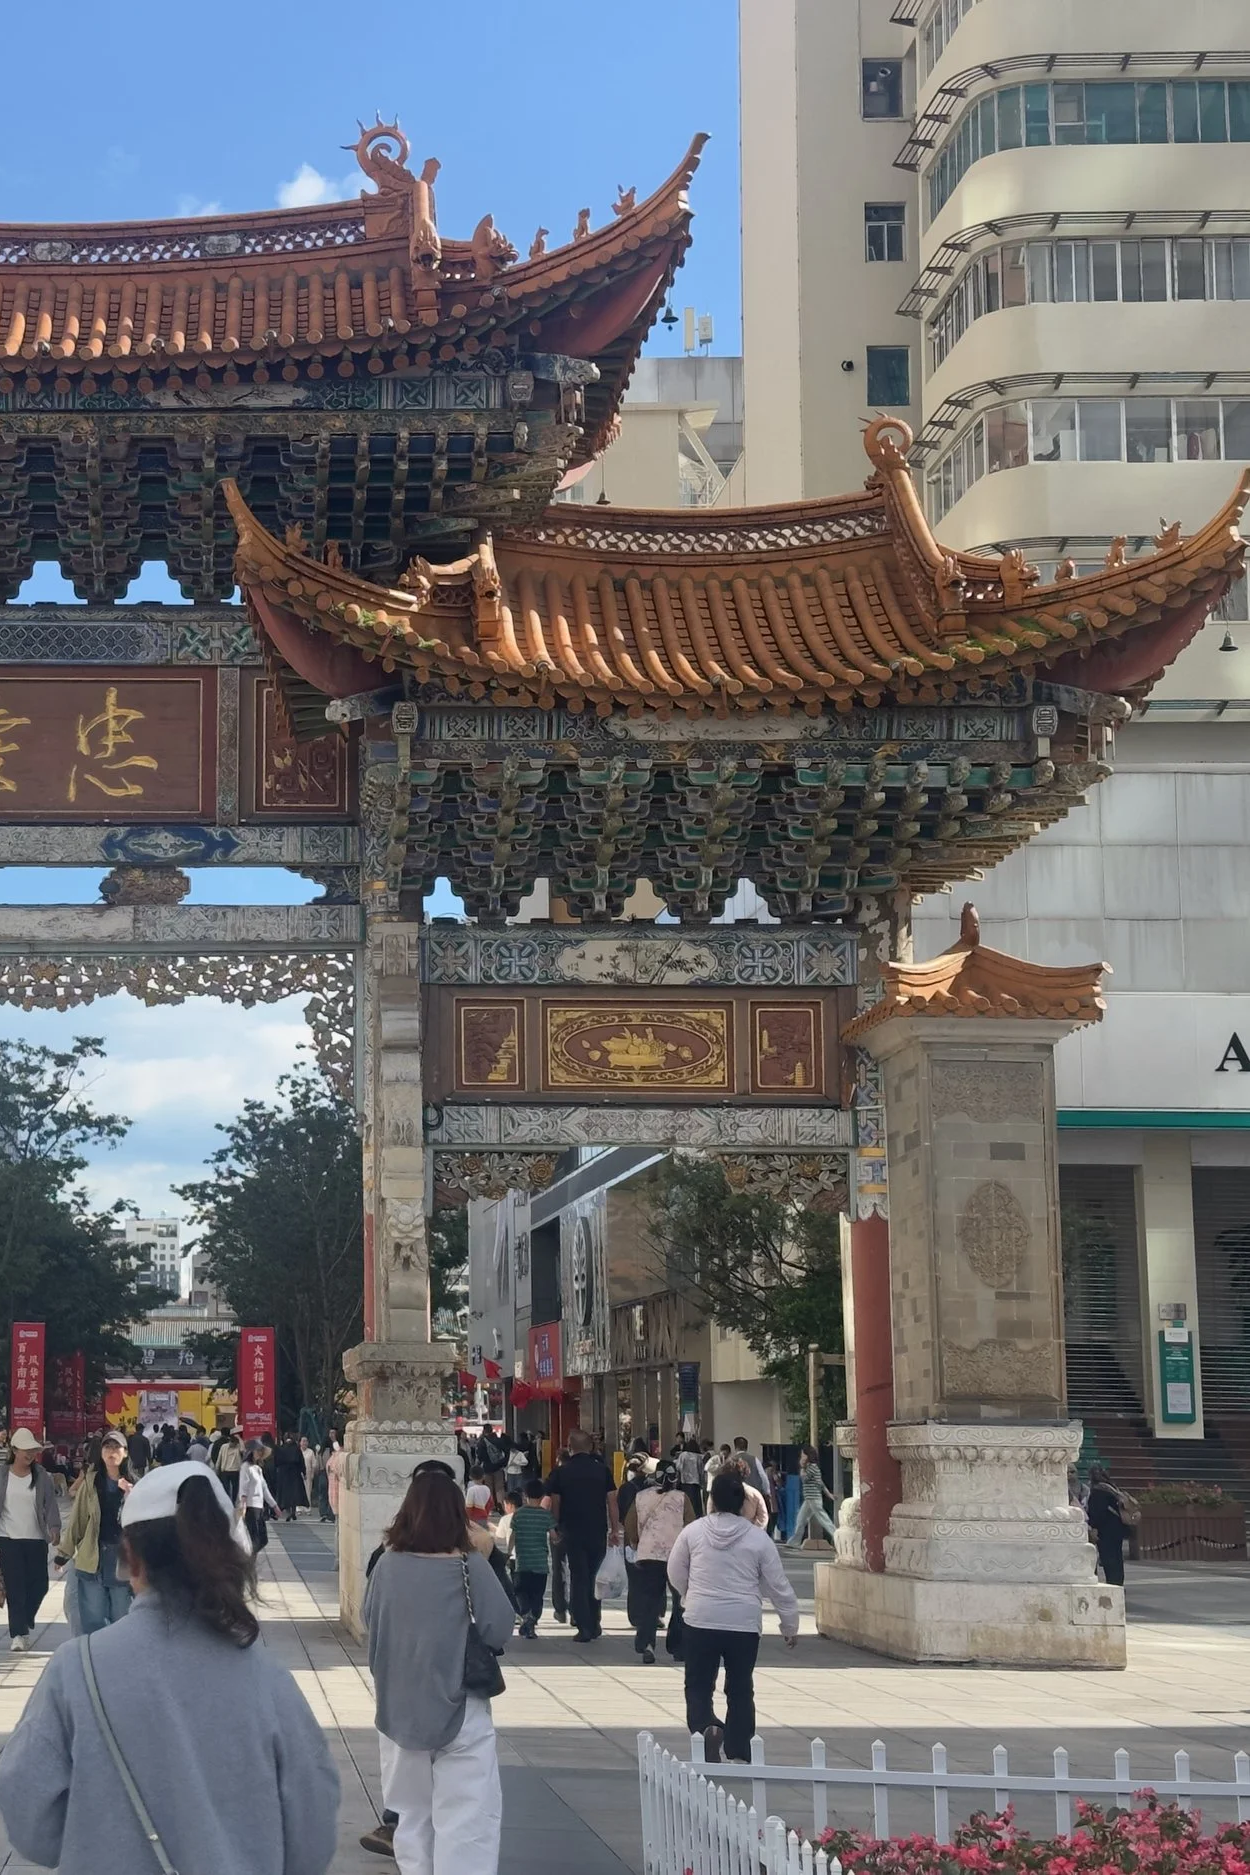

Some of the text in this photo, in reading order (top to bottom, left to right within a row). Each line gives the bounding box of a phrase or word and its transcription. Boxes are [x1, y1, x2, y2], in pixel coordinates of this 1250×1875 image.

[17, 1342, 28, 1391] 百年南屏
[28, 1355, 40, 1404] 风华正茂
[253, 1344, 264, 1409] 火热招商中
